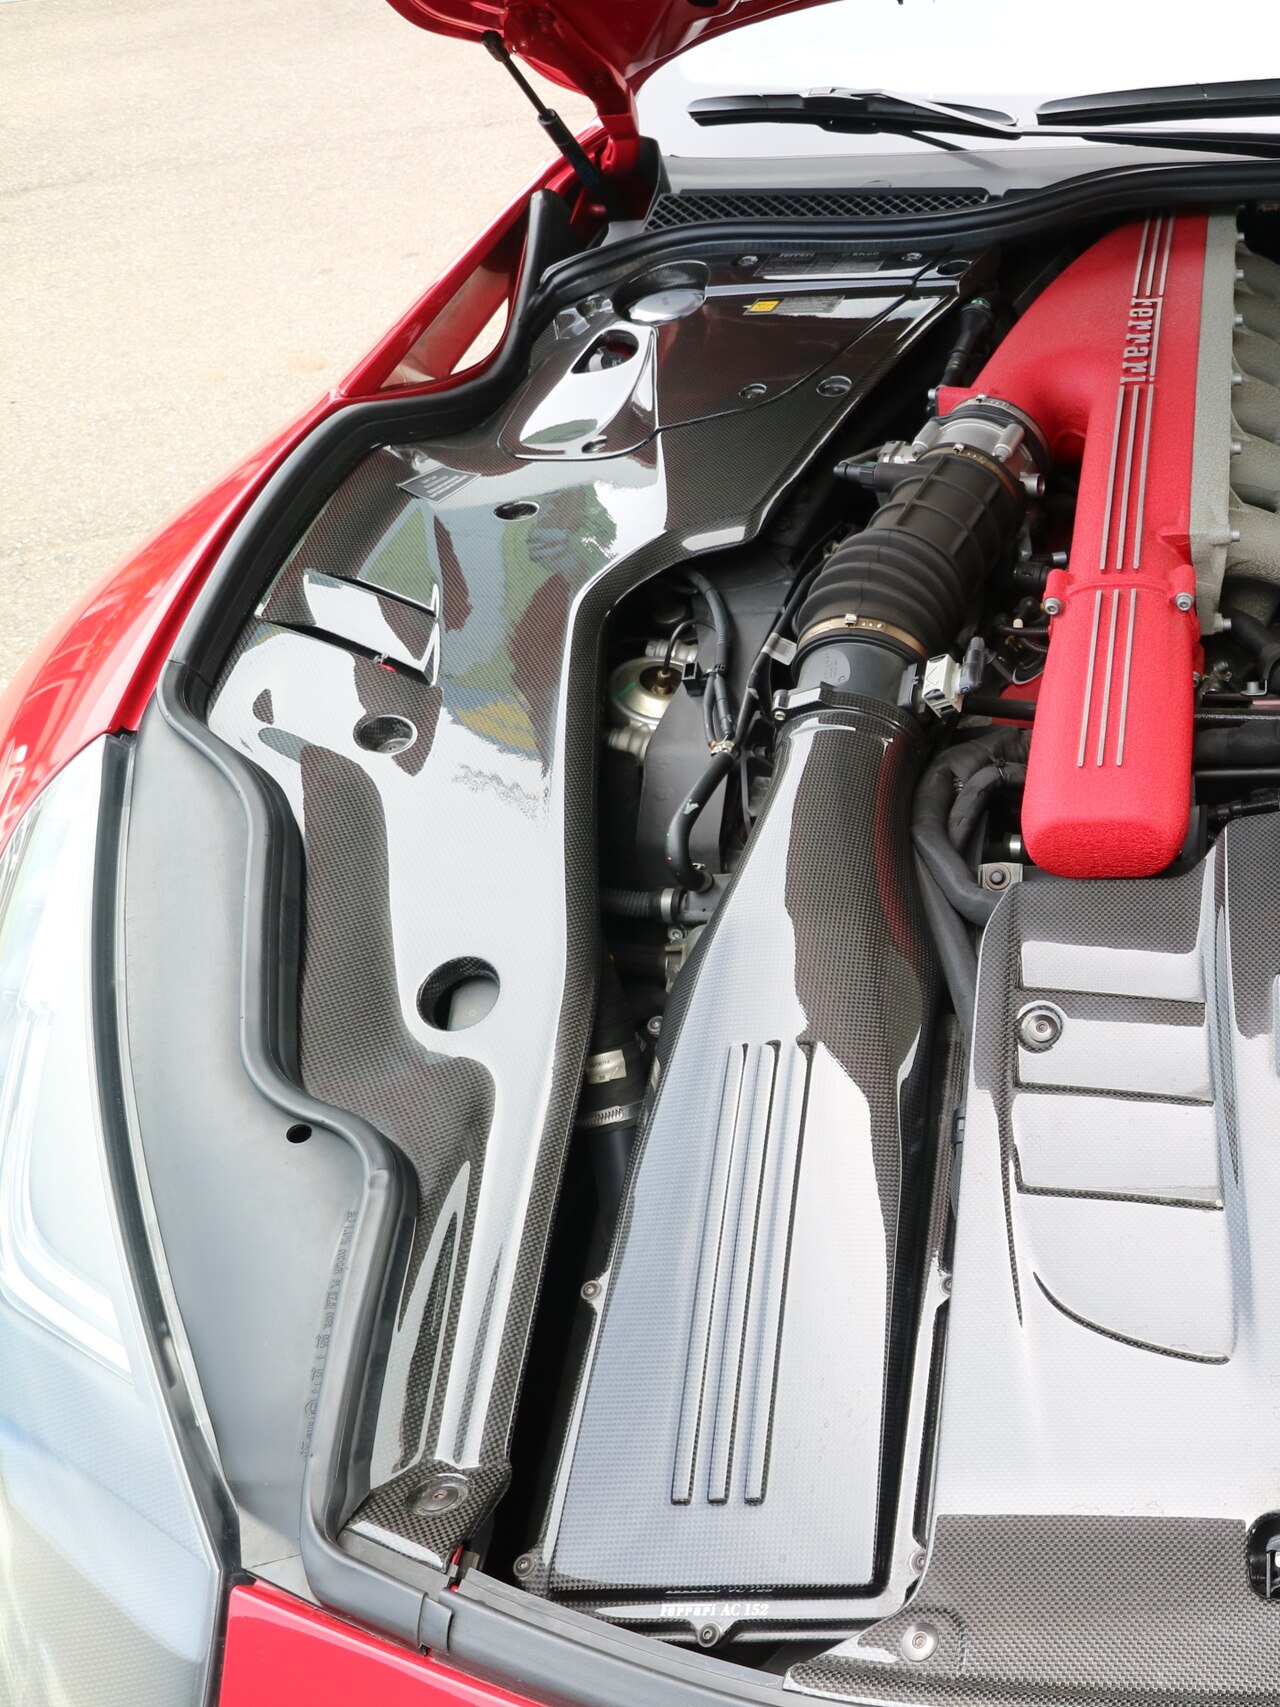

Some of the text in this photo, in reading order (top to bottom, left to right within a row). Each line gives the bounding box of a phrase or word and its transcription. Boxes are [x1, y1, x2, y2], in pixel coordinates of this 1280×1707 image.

[1120, 297, 1163, 384] Ferrari
[660, 1603, 769, 1617] Ferrari AC 152
